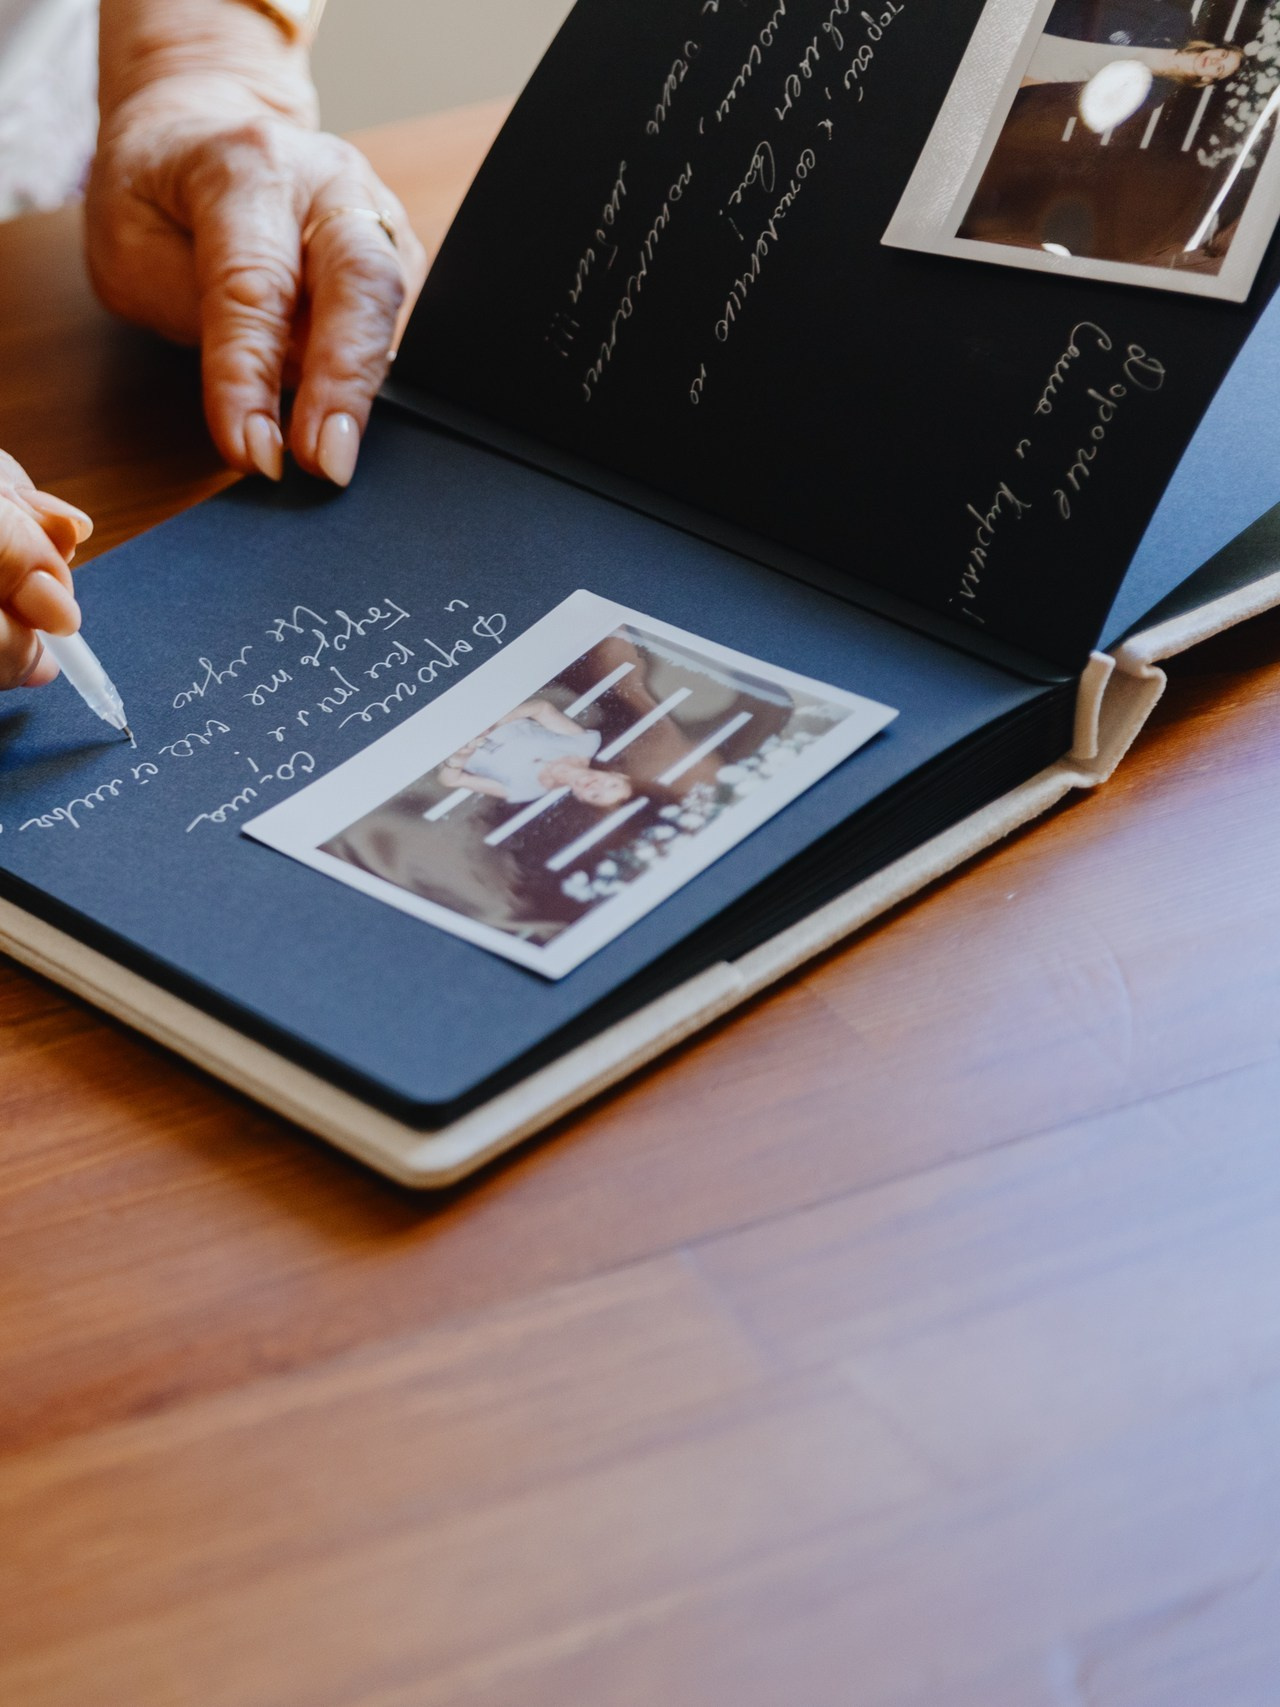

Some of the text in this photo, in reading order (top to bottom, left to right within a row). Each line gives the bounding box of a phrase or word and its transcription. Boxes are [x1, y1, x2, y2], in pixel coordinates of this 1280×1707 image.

[1034, 320, 1113, 416] Саша
[1016, 438, 1032, 459] и
[1052, 343, 1166, 520] Дорогие
[444, 598, 469, 613] и
